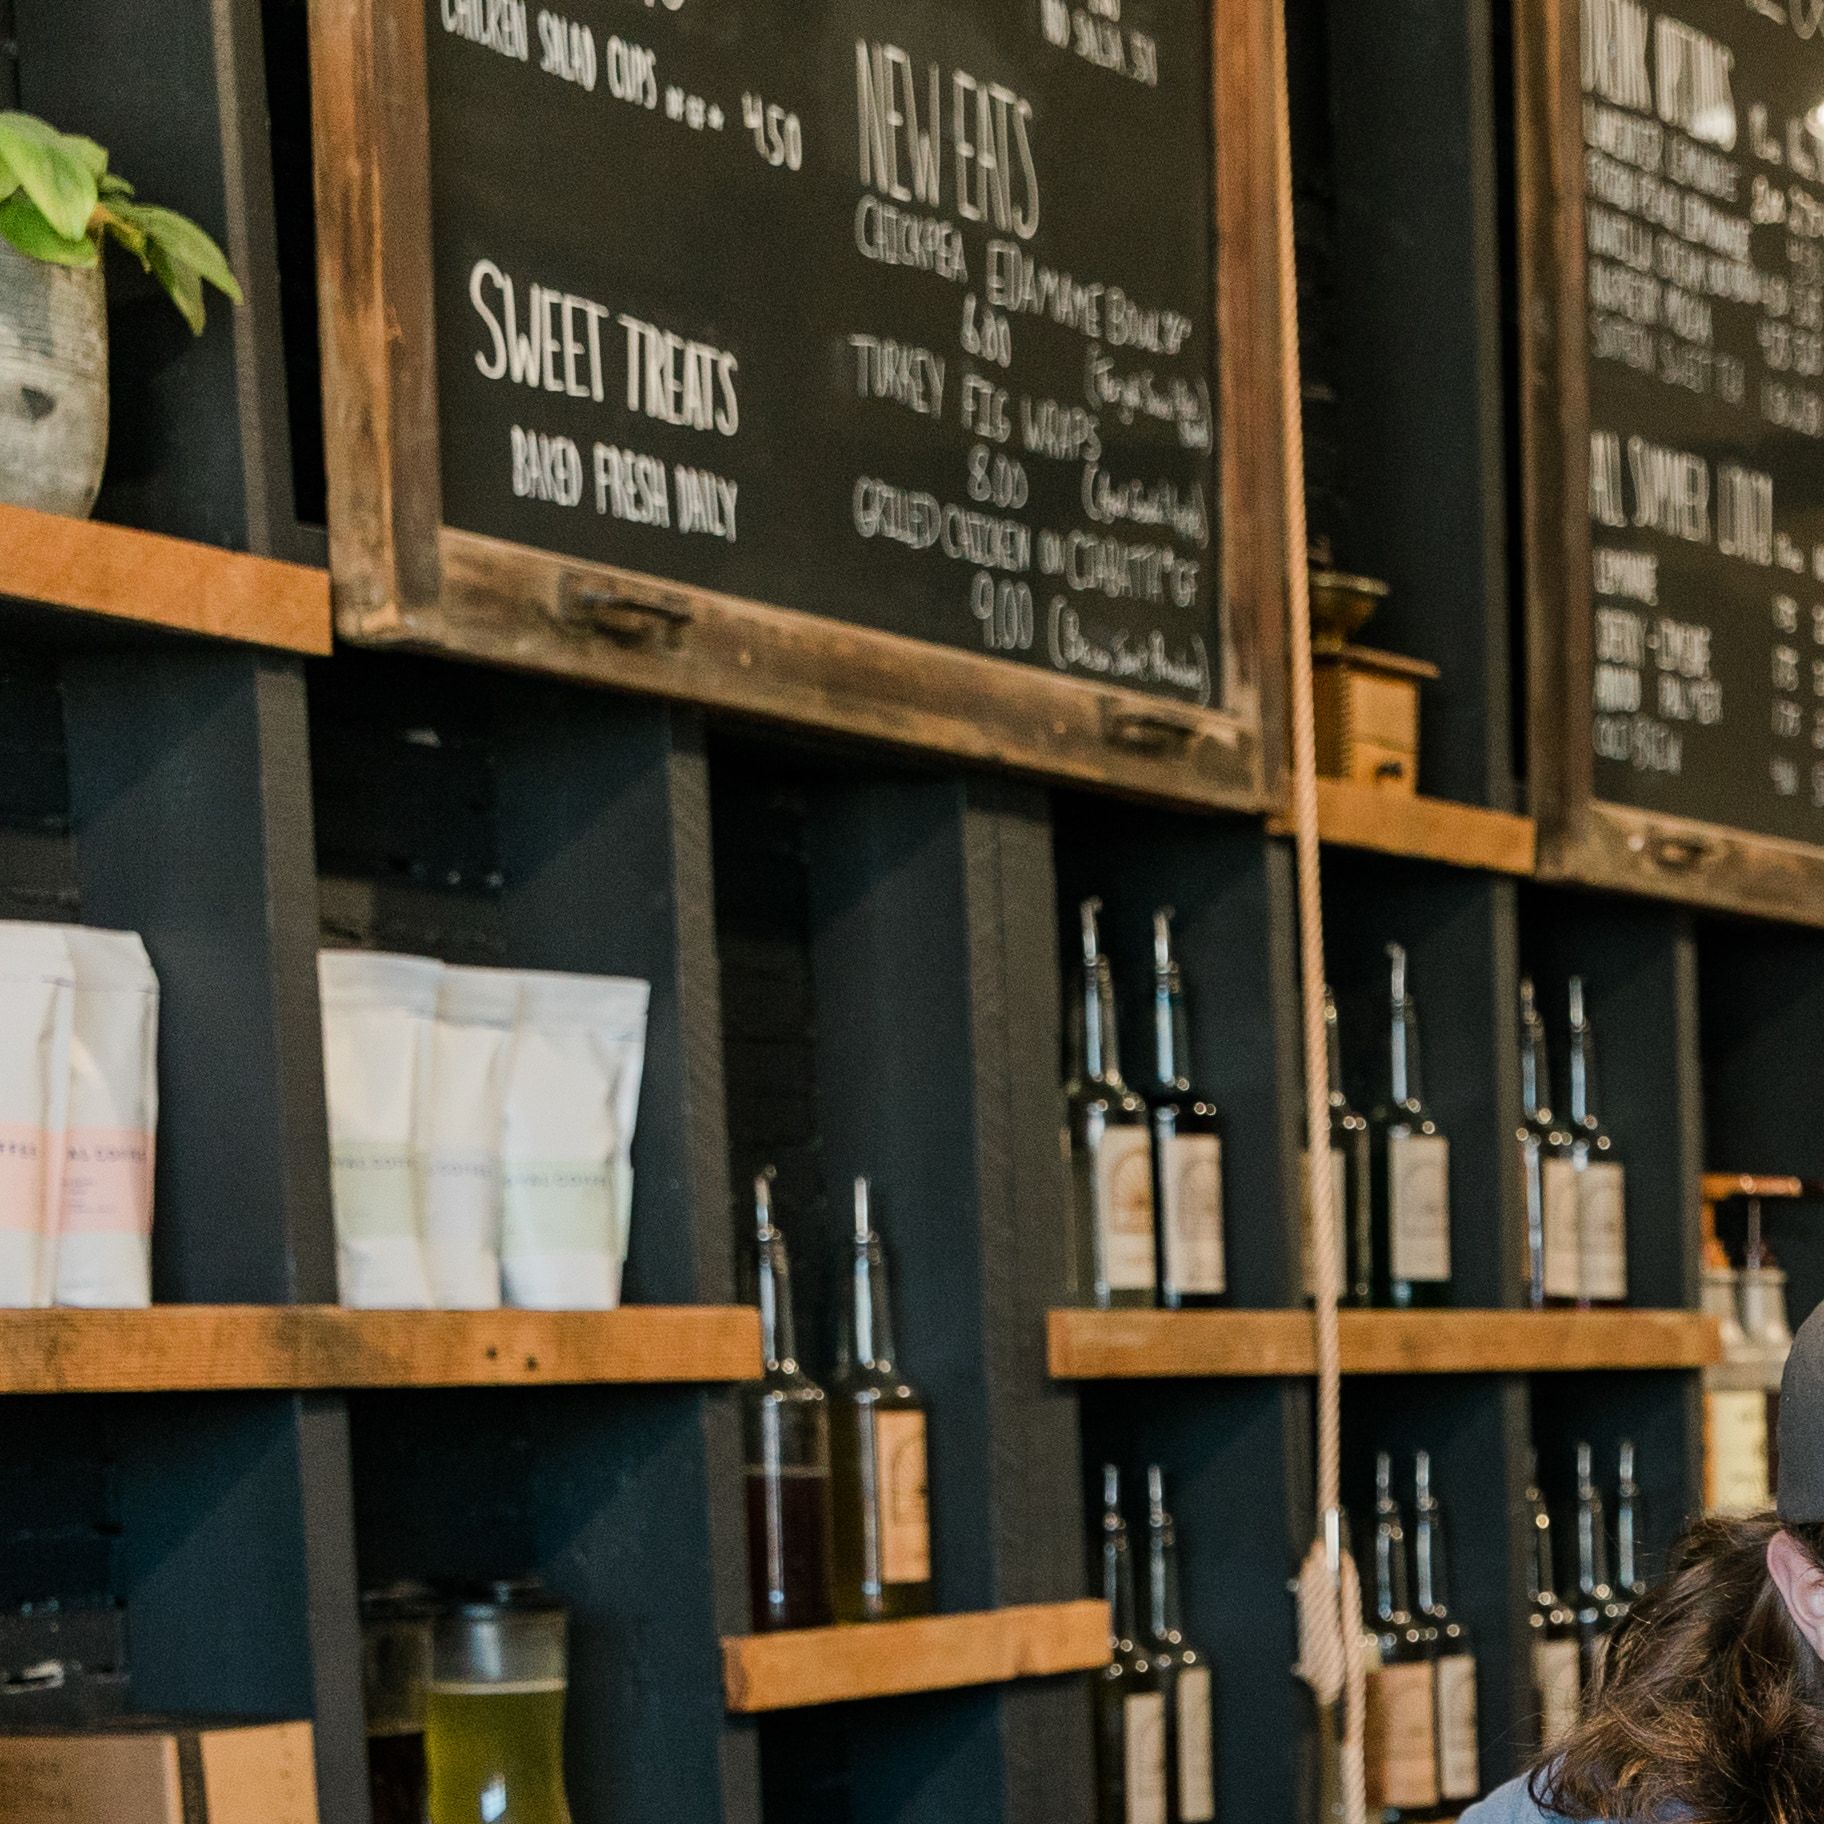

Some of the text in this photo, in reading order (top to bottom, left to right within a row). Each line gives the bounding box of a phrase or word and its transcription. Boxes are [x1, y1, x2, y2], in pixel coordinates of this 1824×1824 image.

[537, 9, 597, 92] SALAD
[607, 35, 657, 110] CUPS
[856, 37, 941, 208] NEW
[953, 68, 1040, 240] EATS
[853, 194, 969, 284] CHICKPEA
[986, 239, 1105, 338] EDAMAME
[469, 258, 739, 437] SWEET TREATS
[849, 333, 946, 419] TURKEY
[962, 373, 1012, 443] FIG
[1021, 393, 1101, 461] WRAPS
[511, 424, 738, 544] BAKED FRESH DAILY
[853, 475, 942, 550] GRILLED
[941, 503, 1031, 573] CHICKEN
